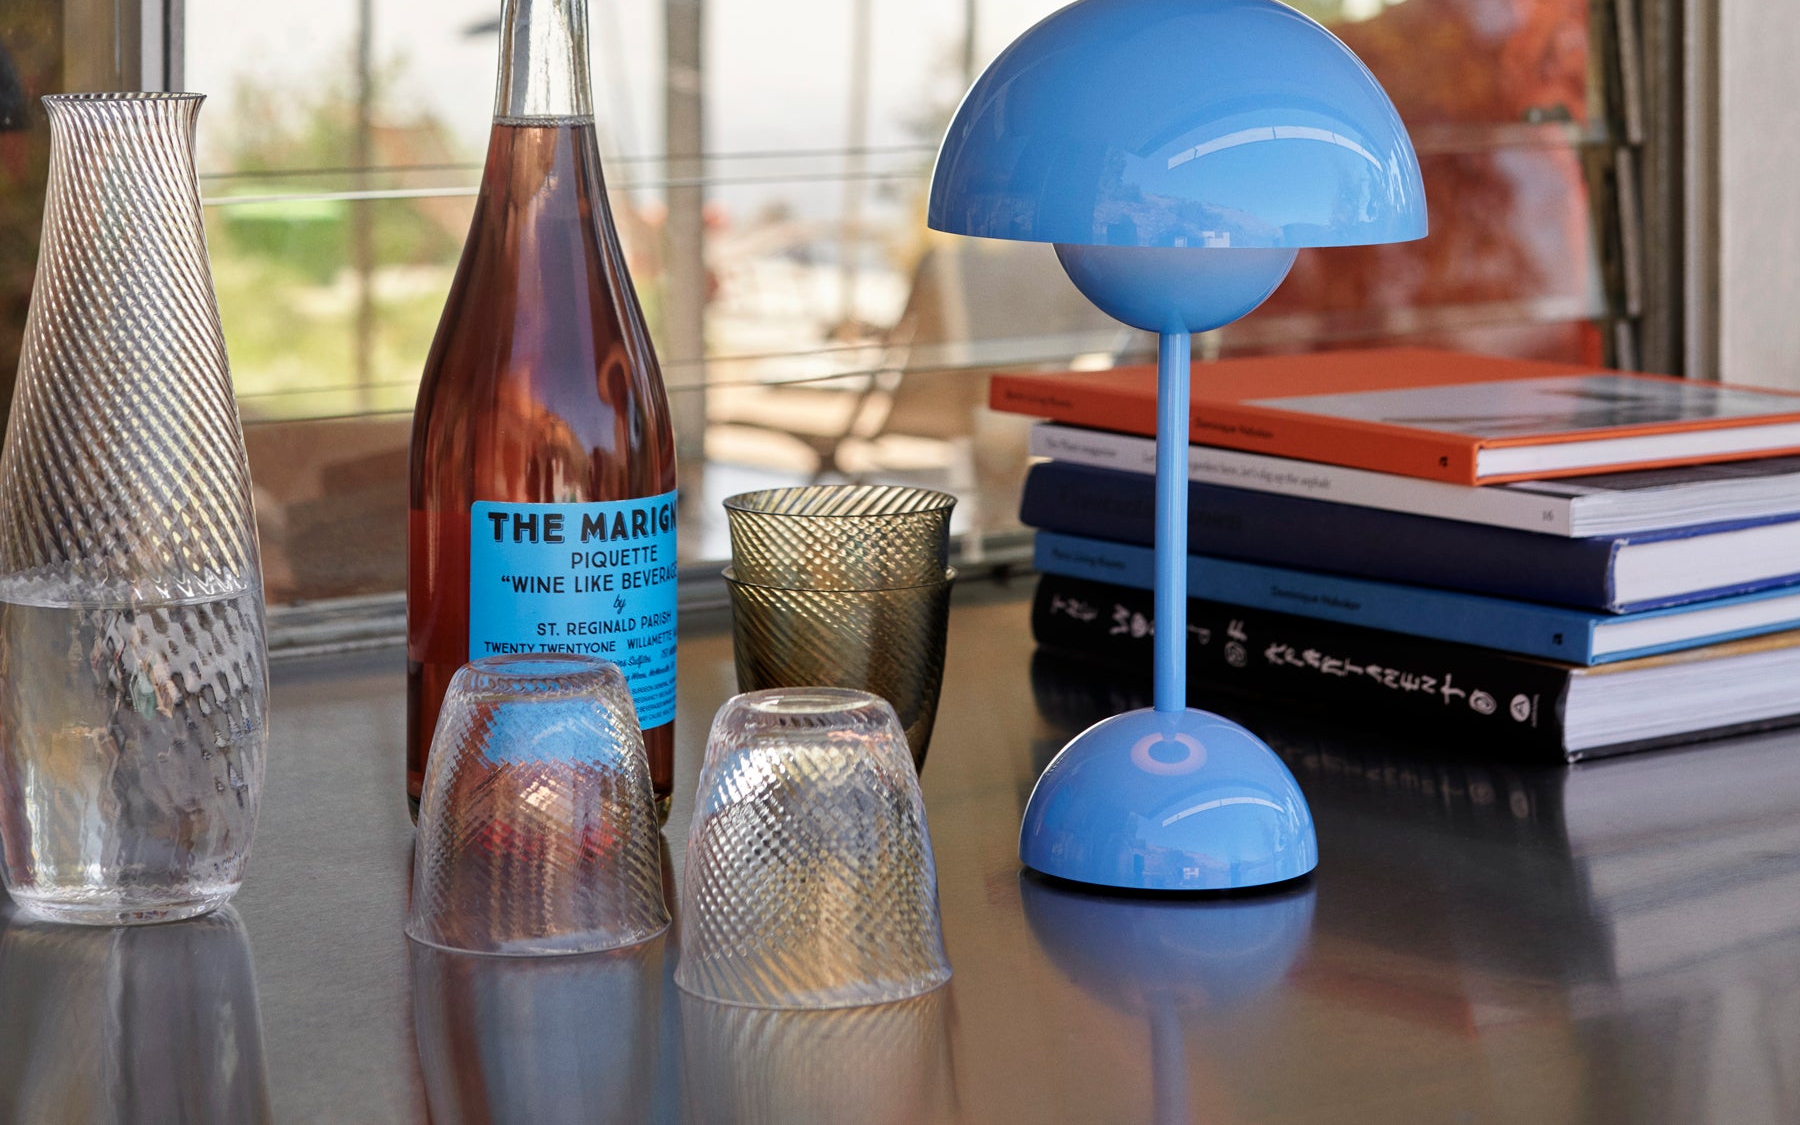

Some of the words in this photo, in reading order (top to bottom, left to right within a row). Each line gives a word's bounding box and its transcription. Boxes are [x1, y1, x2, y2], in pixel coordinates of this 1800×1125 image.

[488, 513, 565, 543] THE
[572, 545, 657, 569] PIQUETTE
[502, 576, 565, 594] “WINE
[575, 575, 614, 593] LIKE
[612, 594, 626, 614] by
[537, 623, 560, 636] ST.
[567, 619, 636, 636] REGINALD
[642, 612, 672, 630] PARISH
[485, 642, 535, 653] TWENTY
[540, 642, 616, 653] TWENTYONE
[628, 630, 673, 650] WILLAMETTE
